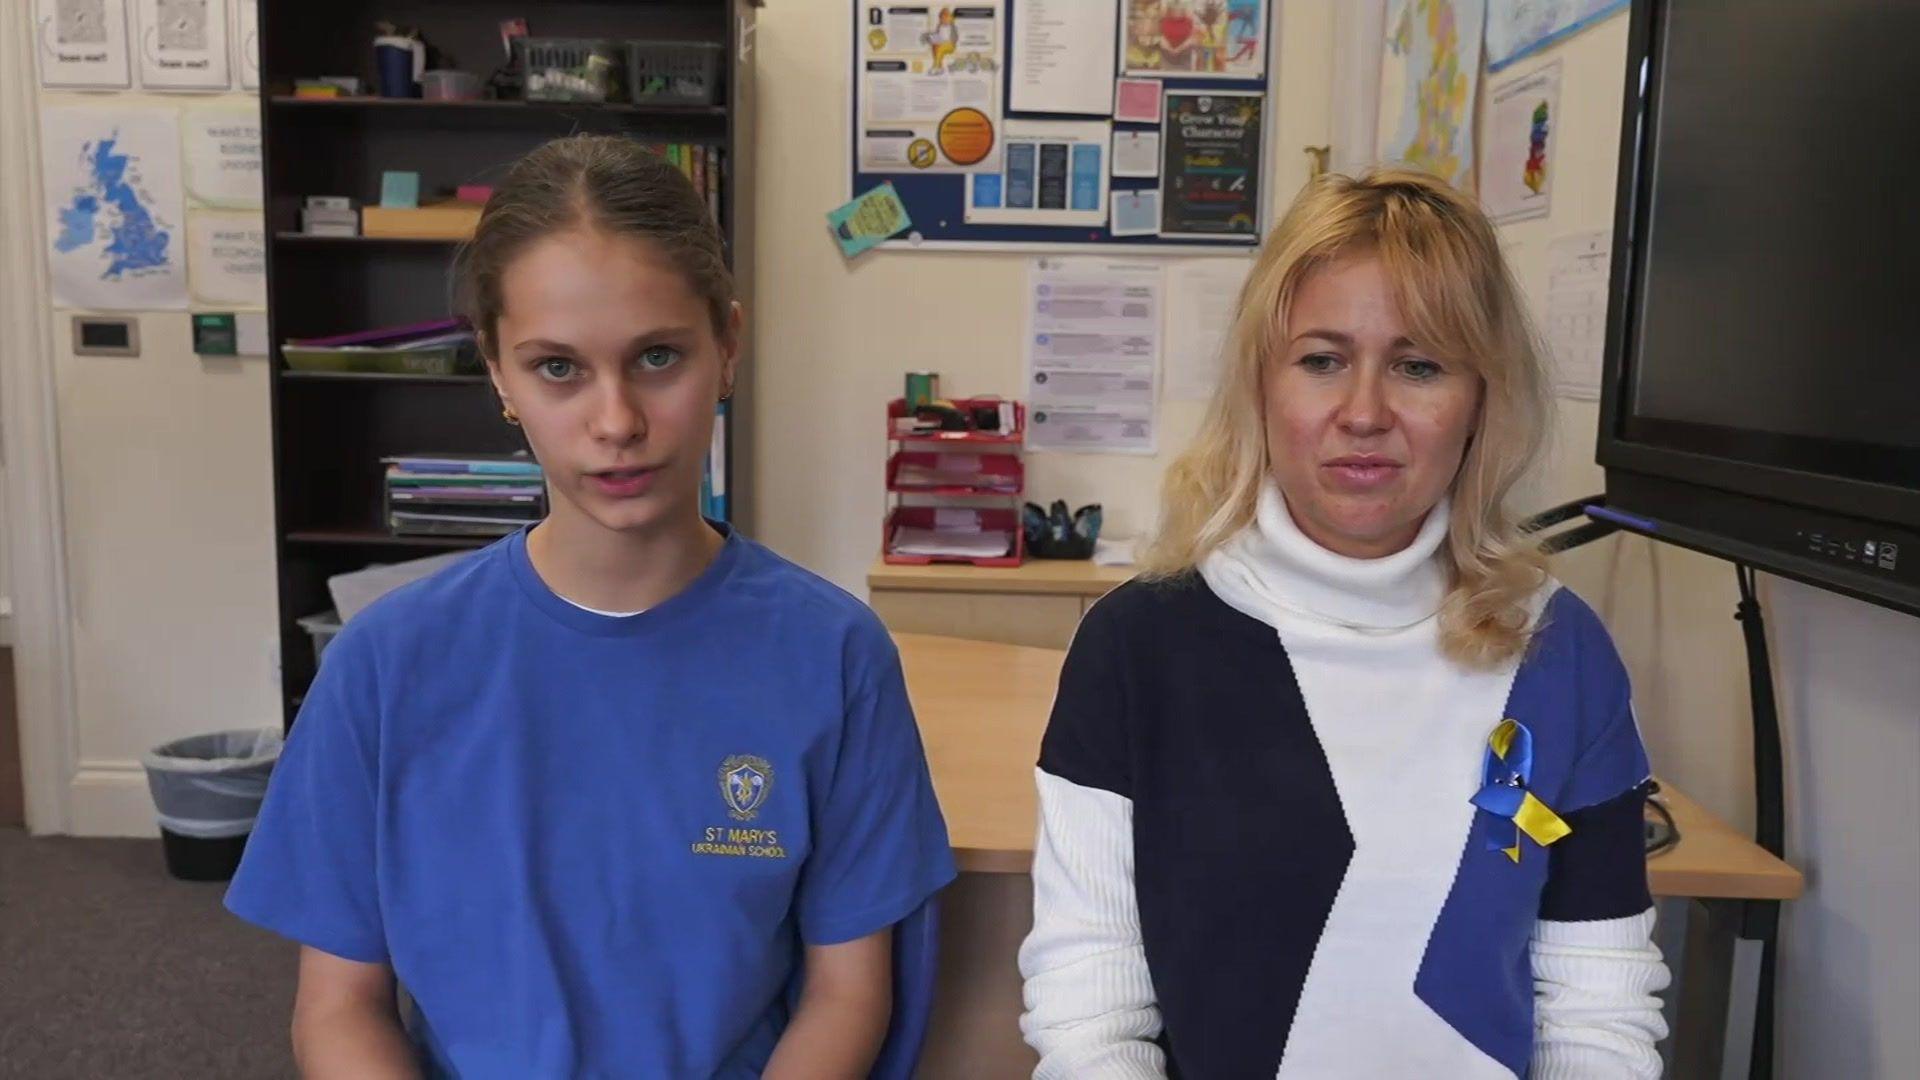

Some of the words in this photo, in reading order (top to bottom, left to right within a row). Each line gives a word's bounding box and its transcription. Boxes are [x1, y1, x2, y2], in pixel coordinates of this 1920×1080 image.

[705, 827, 724, 842] ST
[728, 829, 777, 844] MARY'S
[691, 843, 746, 856] UKRAINIAN
[748, 845, 786, 858] SCHOOL
